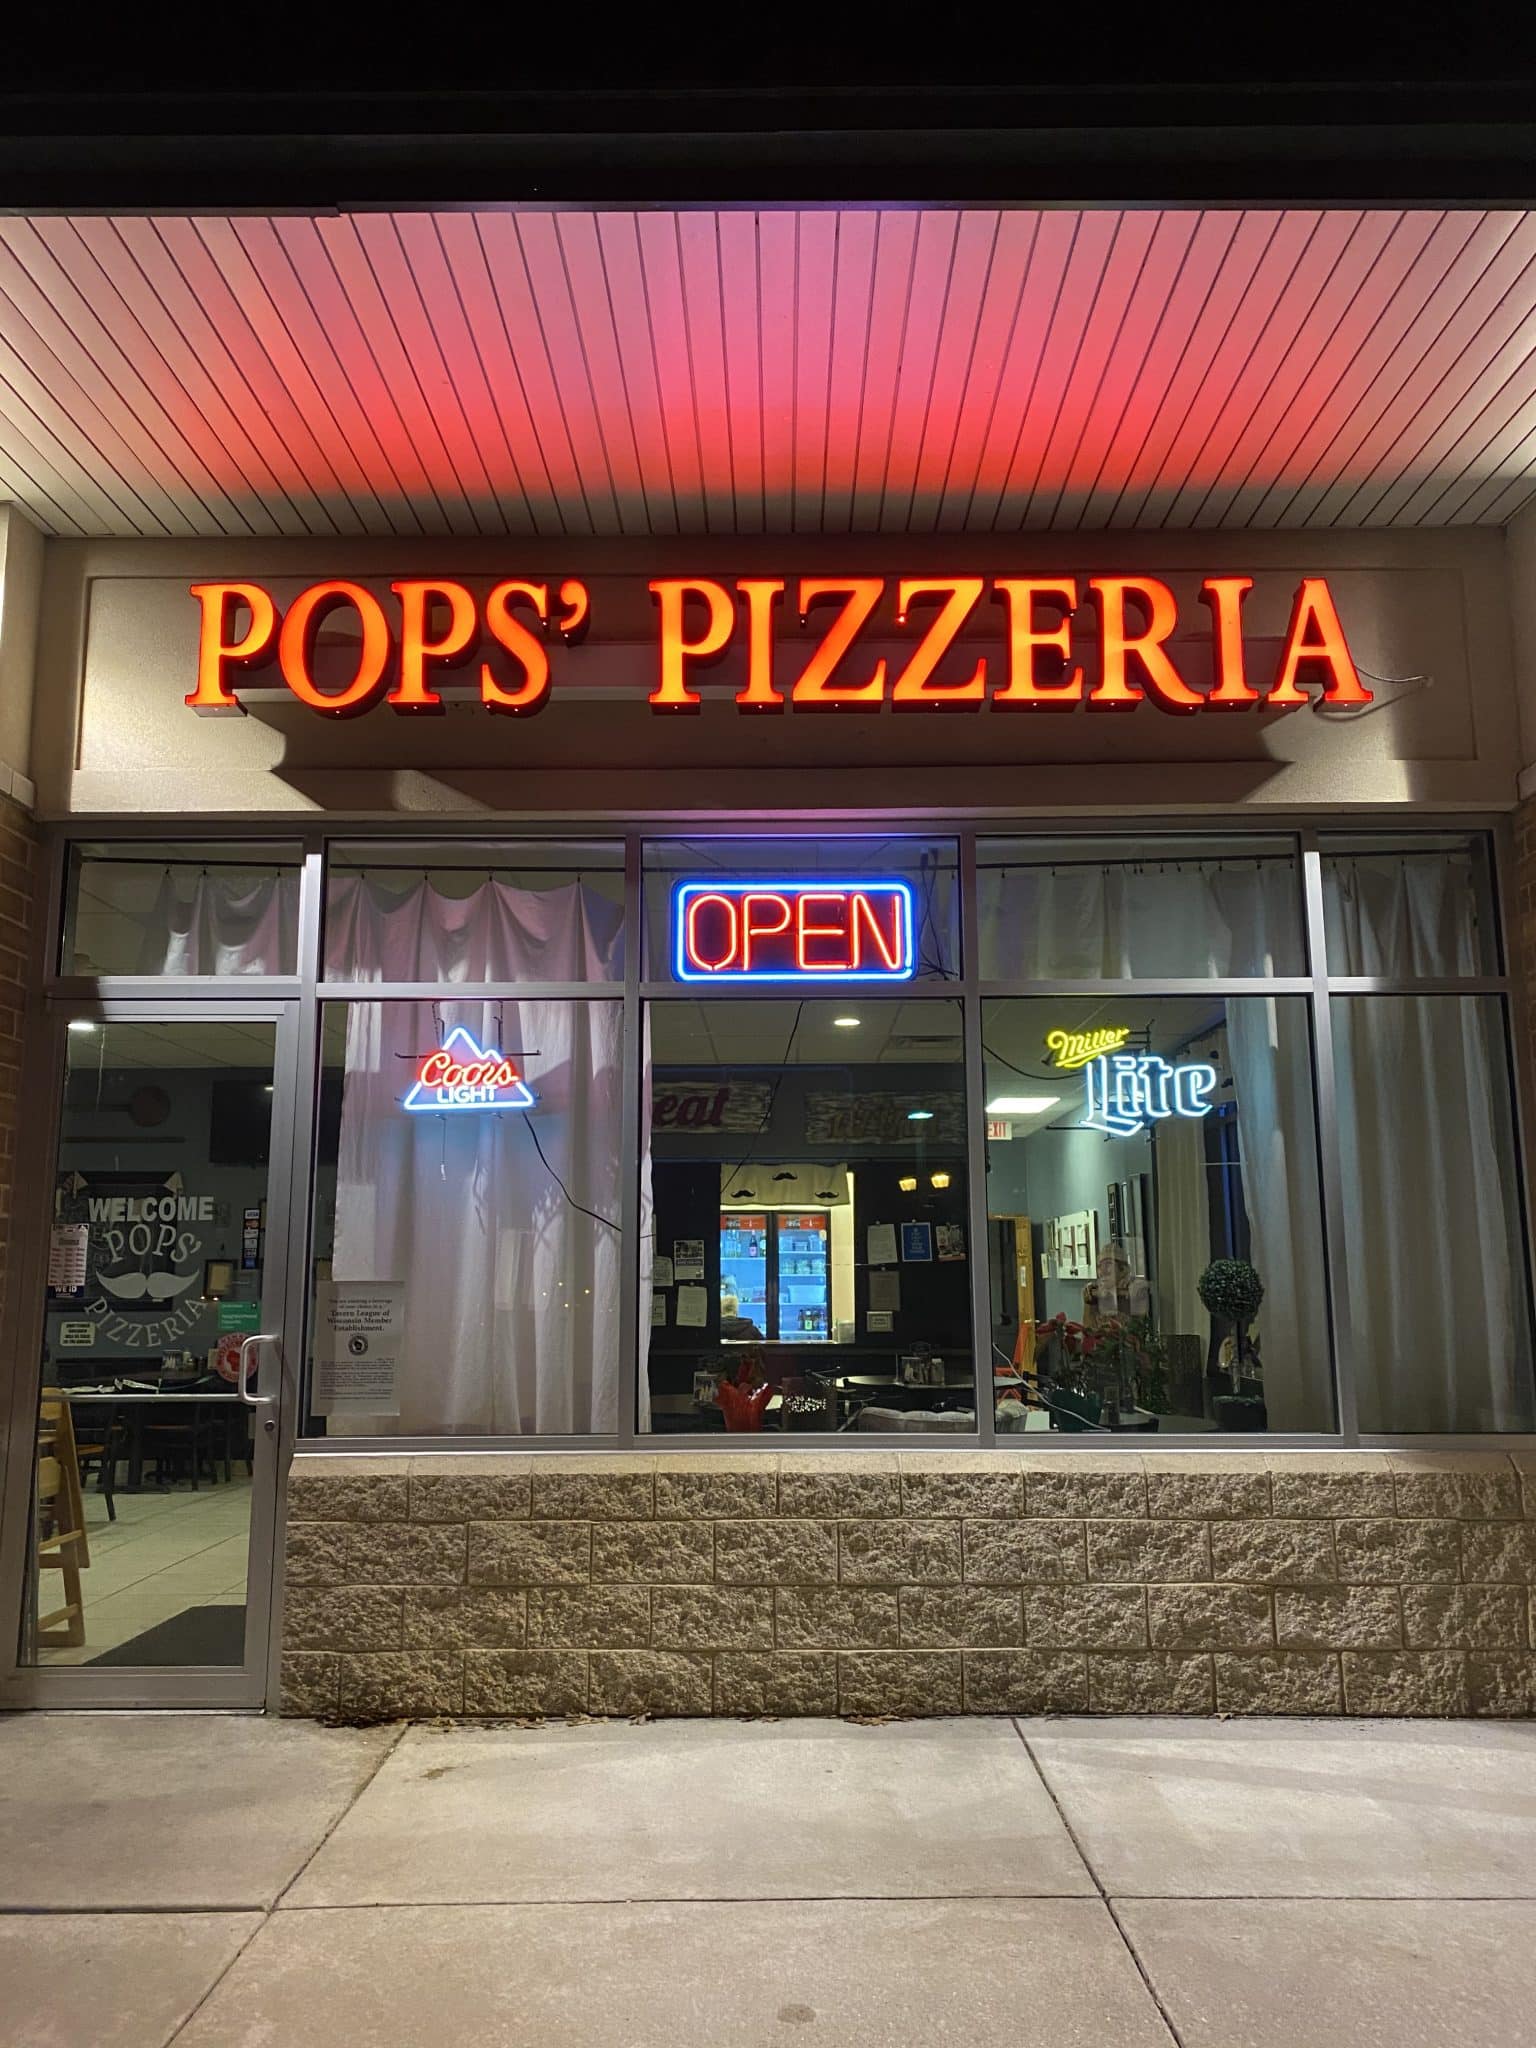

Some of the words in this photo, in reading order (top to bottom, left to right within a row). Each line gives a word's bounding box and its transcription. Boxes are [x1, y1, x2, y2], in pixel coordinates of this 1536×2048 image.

[648, 577, 1374, 704] PIZZERIA
[686, 891, 903, 971] OPEN
[1047, 1028, 1130, 1063] Miller
[420, 1051, 520, 1087] Coors
[436, 1085, 498, 1103] LIGHT
[1080, 1054, 1217, 1137] Lite
[987, 1120, 1007, 1137] EXIT
[88, 1196, 215, 1222] WELCOME
[84, 1296, 208, 1347] PIZZERIA
